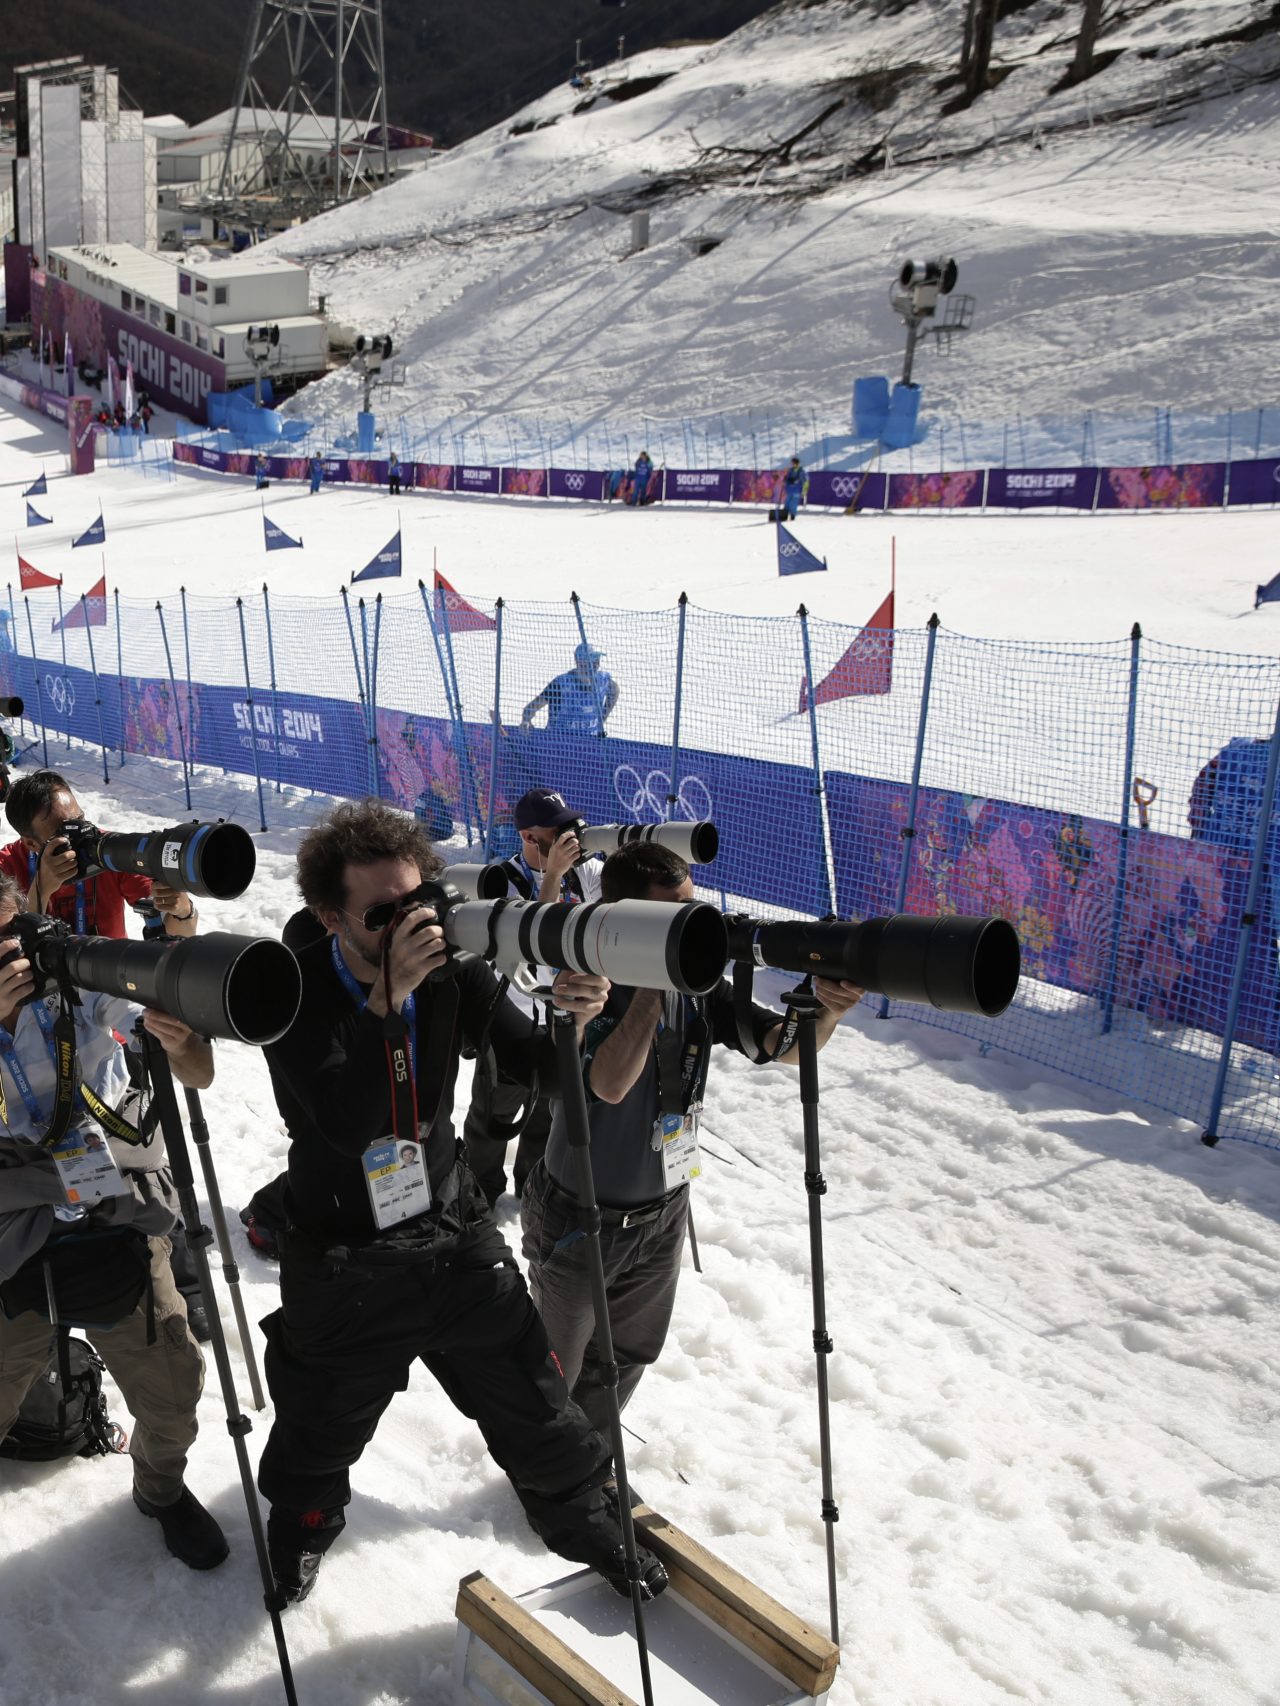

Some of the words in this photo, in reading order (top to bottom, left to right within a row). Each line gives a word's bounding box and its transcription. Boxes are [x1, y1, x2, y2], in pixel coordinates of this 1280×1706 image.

[118, 329, 165, 389] SOCHI
[170, 355, 212, 408] 2014
[676, 474, 699, 485] SOCHI
[700, 474, 719, 485] 2014
[1006, 474, 1043, 488] SOCHI
[1045, 473, 1076, 488] 2014
[282, 709, 324, 743] 2014
[783, 1021, 798, 1044] NPS
[61, 1041, 72, 1077] Nikon
[394, 1049, 407, 1082] EOS
[681, 1055, 696, 1080] NPS
[94, 1106, 119, 1129] Nikon
[380, 1166, 392, 1176] EP
